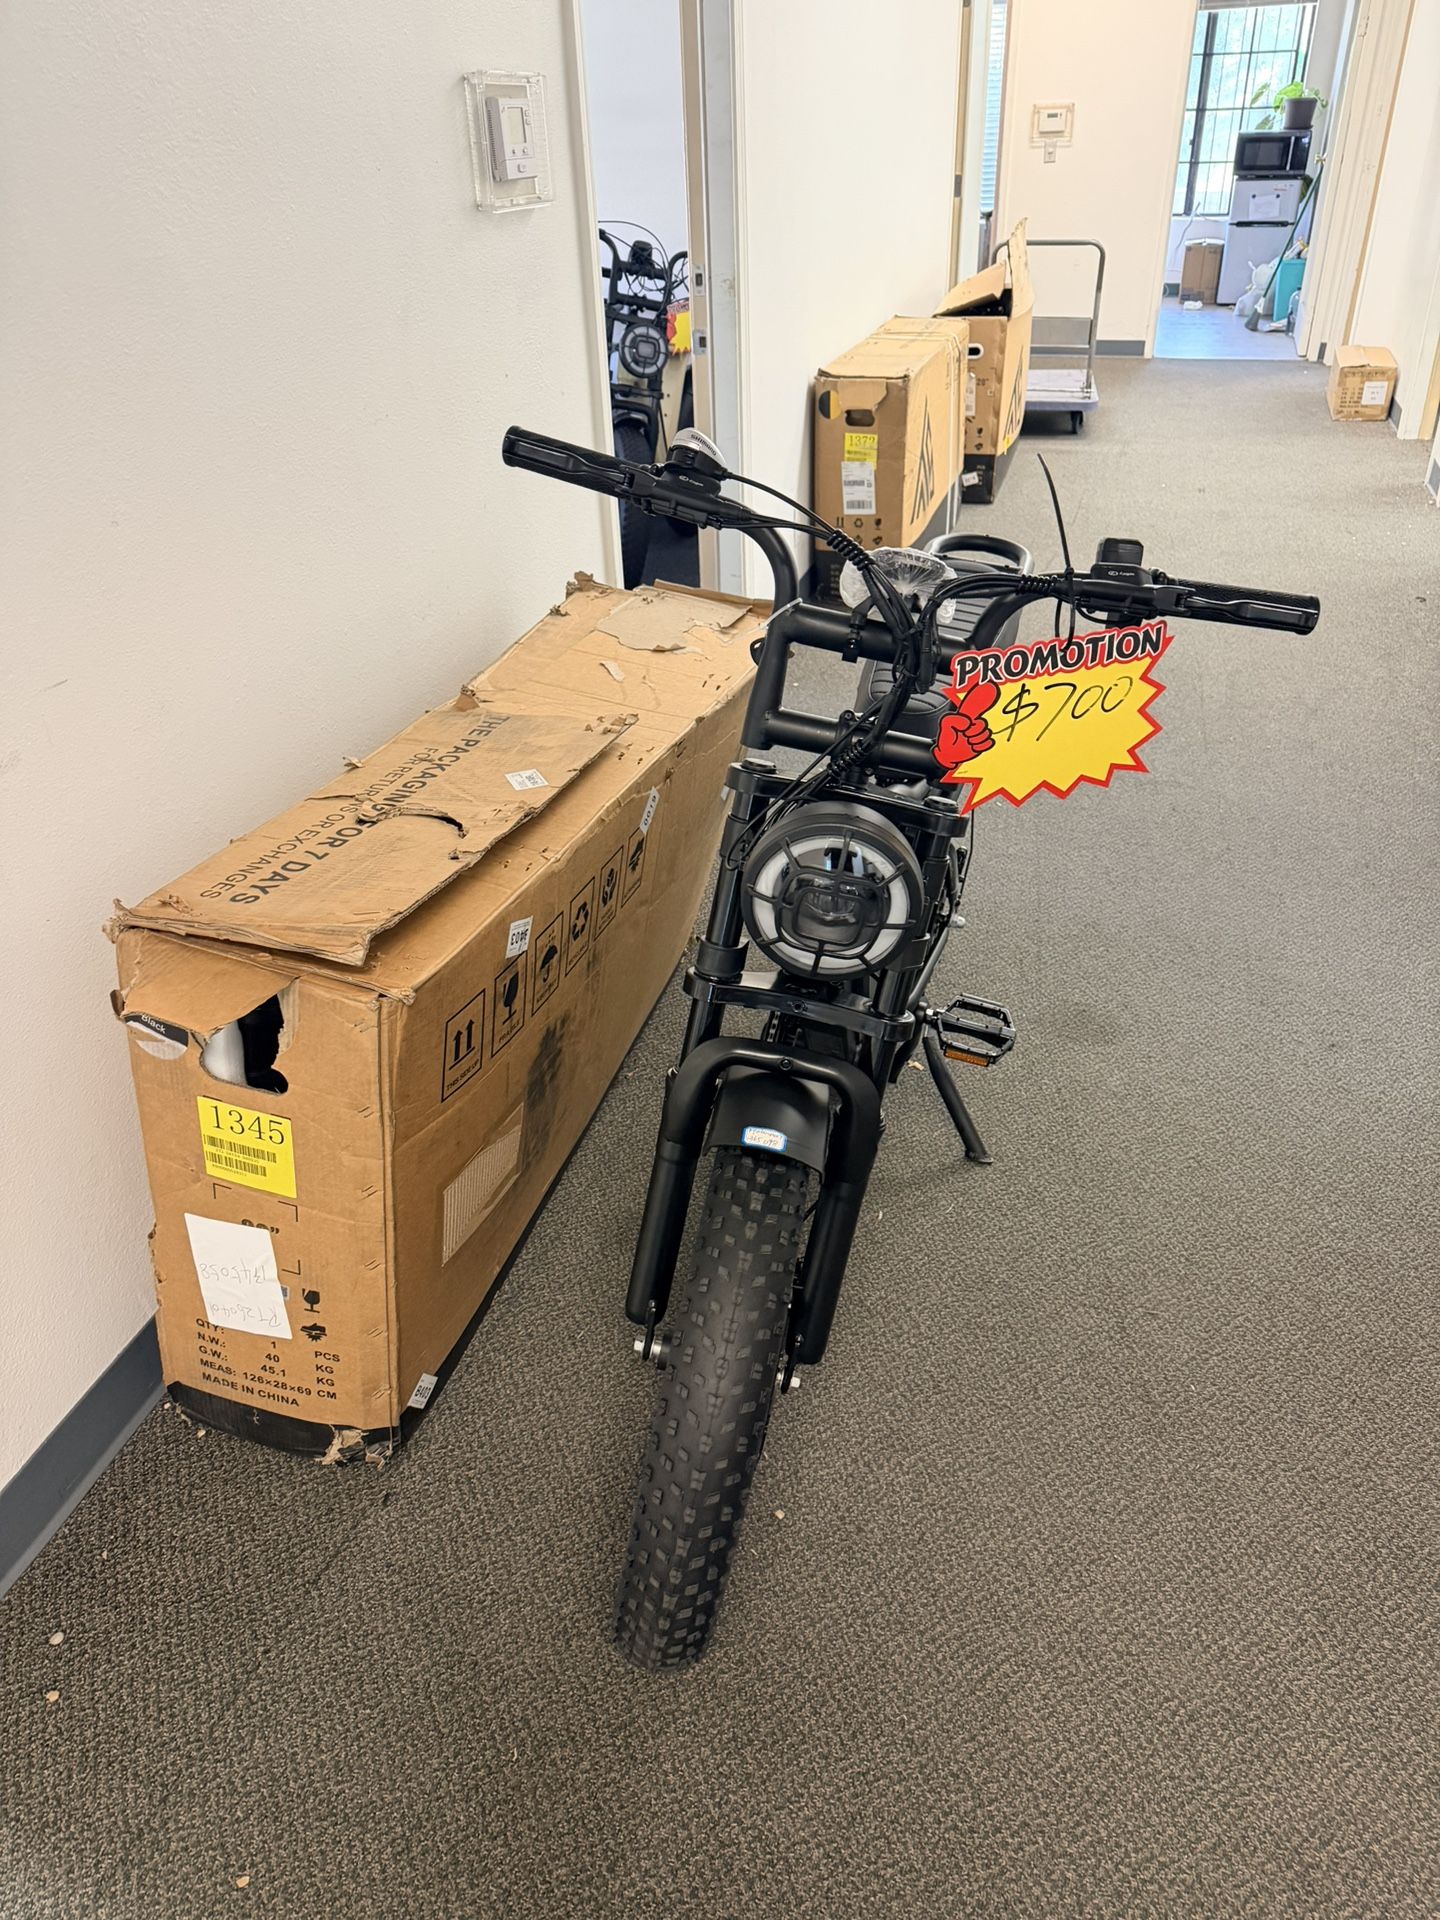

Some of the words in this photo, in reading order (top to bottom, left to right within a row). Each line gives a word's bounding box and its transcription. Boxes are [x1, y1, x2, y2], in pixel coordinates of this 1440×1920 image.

[956, 623, 1165, 689] PROMOTION
[468, 716, 511, 737] THE
[992, 676, 1134, 742] $700
[371, 738, 481, 812] PACKAGING
[408, 747, 439, 766] FOR
[312, 813, 345, 829] OR
[200, 829, 321, 899] EXCHANGES
[304, 850, 330, 861] 7
[229, 860, 312, 904] DAYS
[141, 1014, 167, 1034] Black
[210, 1105, 285, 1145] 1345
[196, 1318, 225, 1335] QTY:
[314, 1350, 341, 1362] PCS
[197, 1331, 226, 1348] N.W.:
[265, 1352, 280, 1363] 40
[315, 1363, 334, 1375] KG
[198, 1345, 228, 1362] G.W.:
[260, 1364, 286, 1377] 45.1
[316, 1376, 335, 1387] KG
[199, 1358, 237, 1376] MEAS:
[316, 1388, 338, 1400] CM
[202, 1372, 239, 1391] MADE
[241, 1385, 255, 1395] IN
[257, 1389, 300, 1407] CHINA
